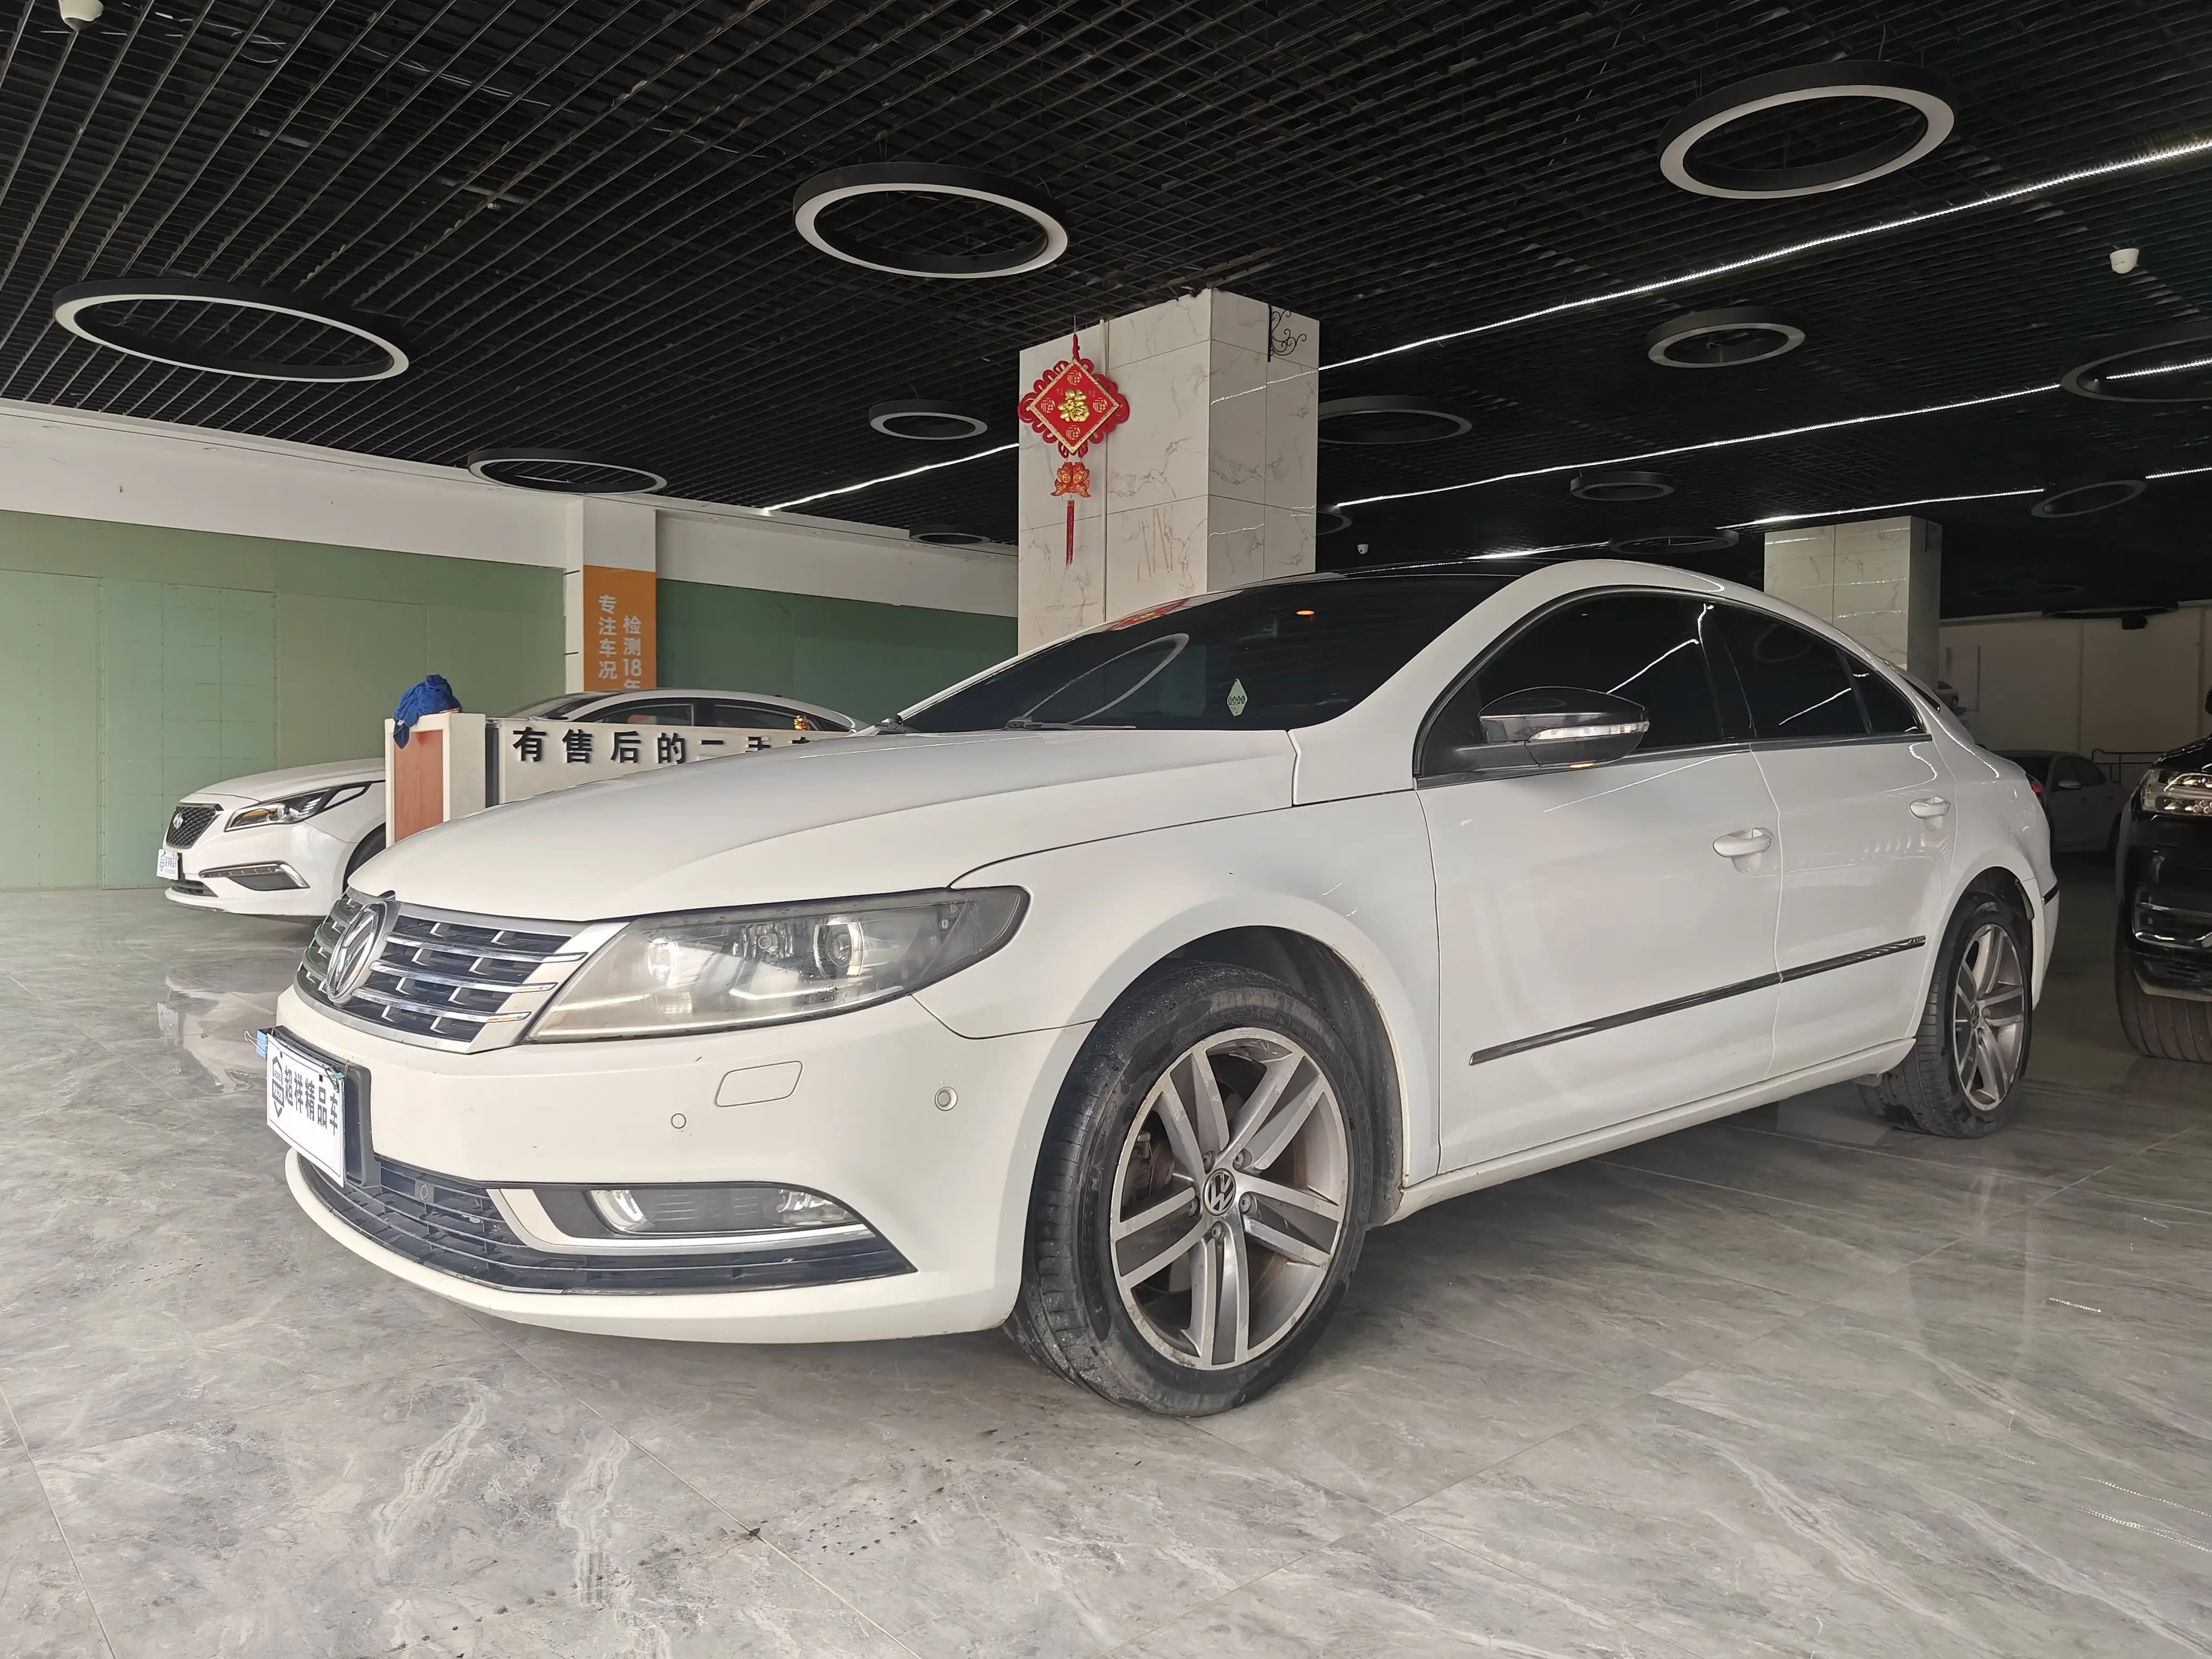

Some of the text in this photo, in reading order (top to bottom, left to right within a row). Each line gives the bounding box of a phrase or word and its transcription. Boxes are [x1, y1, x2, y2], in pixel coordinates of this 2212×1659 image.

[1057, 389, 1090, 422] 福
[598, 594, 617, 679] 专注车况
[512, 726, 812, 764] 有售后的二手
[284, 1065, 338, 1136] 超祥精品车
